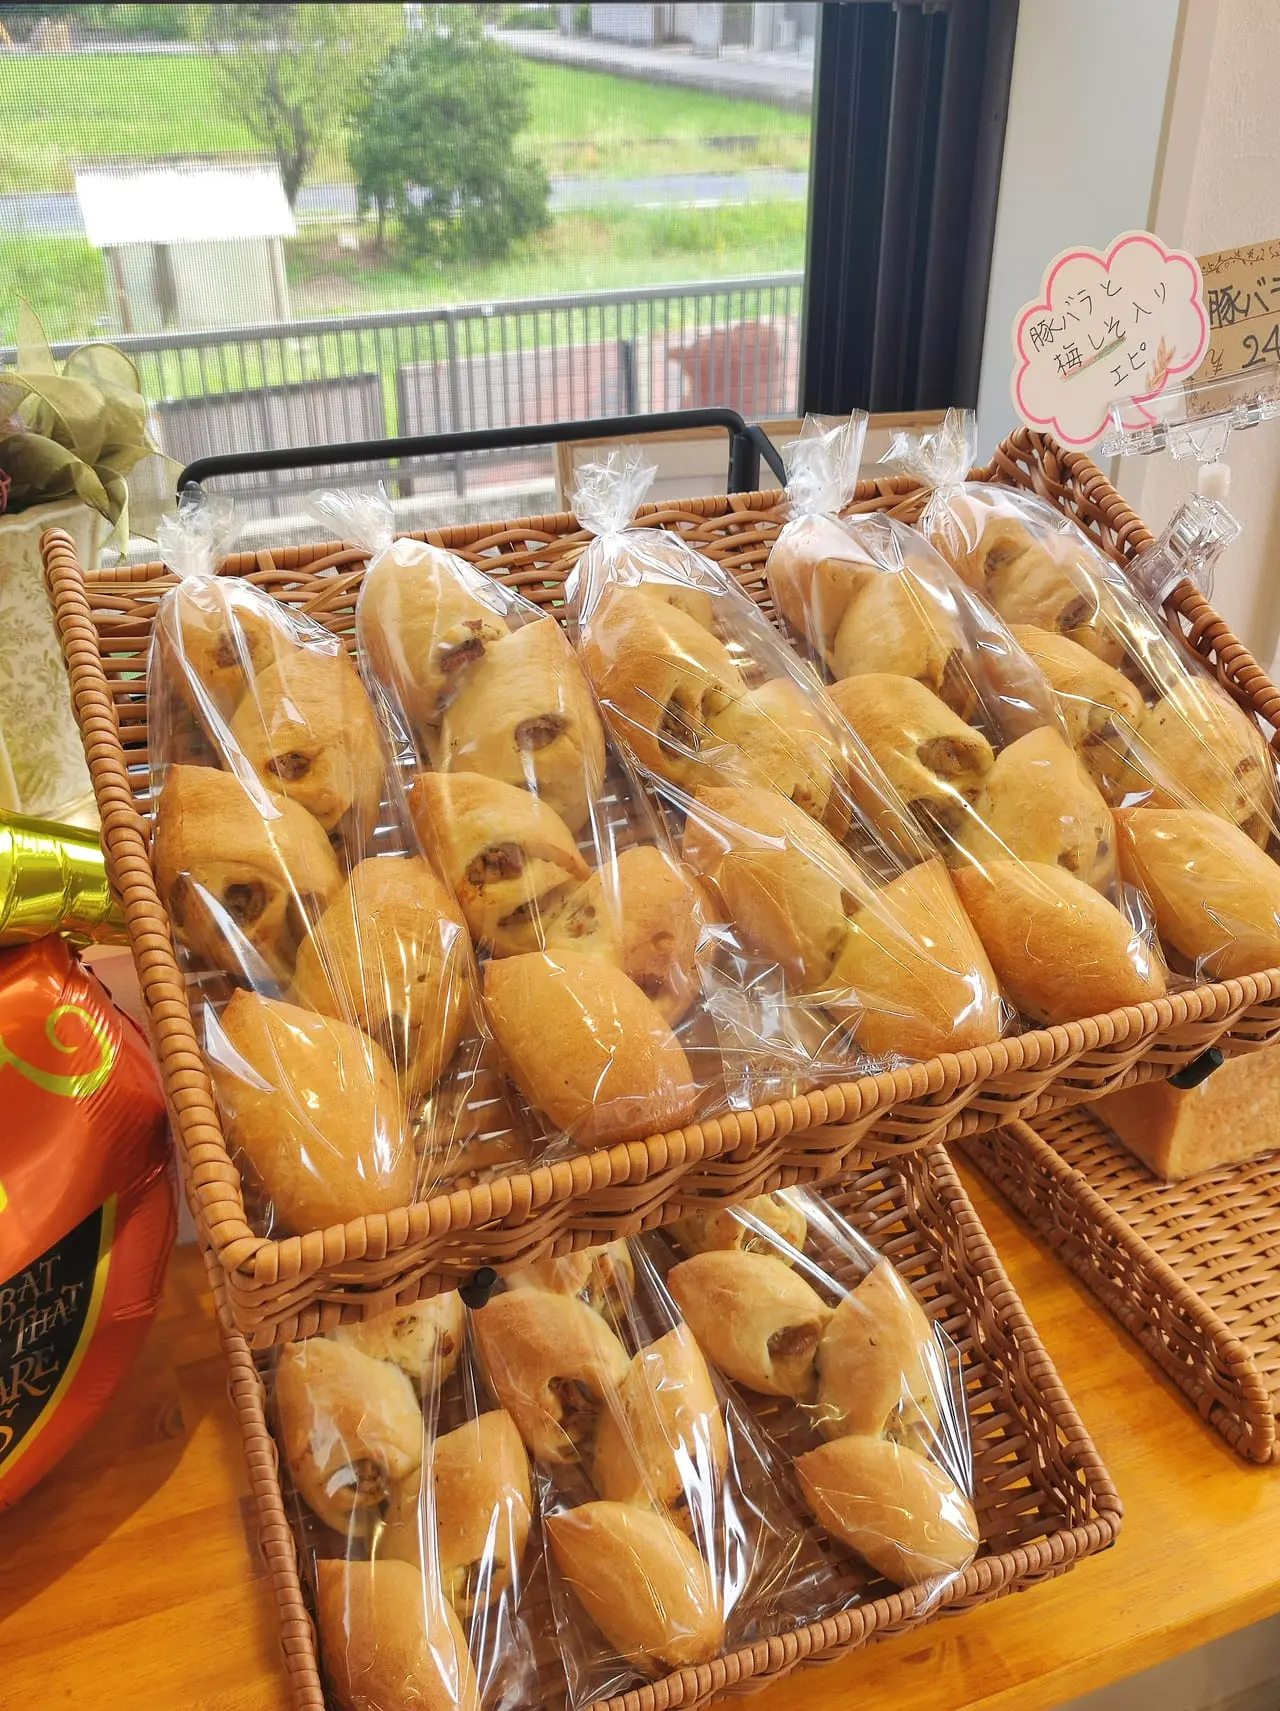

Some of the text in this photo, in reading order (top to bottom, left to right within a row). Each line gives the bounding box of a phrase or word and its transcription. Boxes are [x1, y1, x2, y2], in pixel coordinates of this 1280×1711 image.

[1029, 279, 1122, 353] 豚バラと
[1110, 341, 1147, 387] エピ
[8, 1280, 84, 1359] THAT
